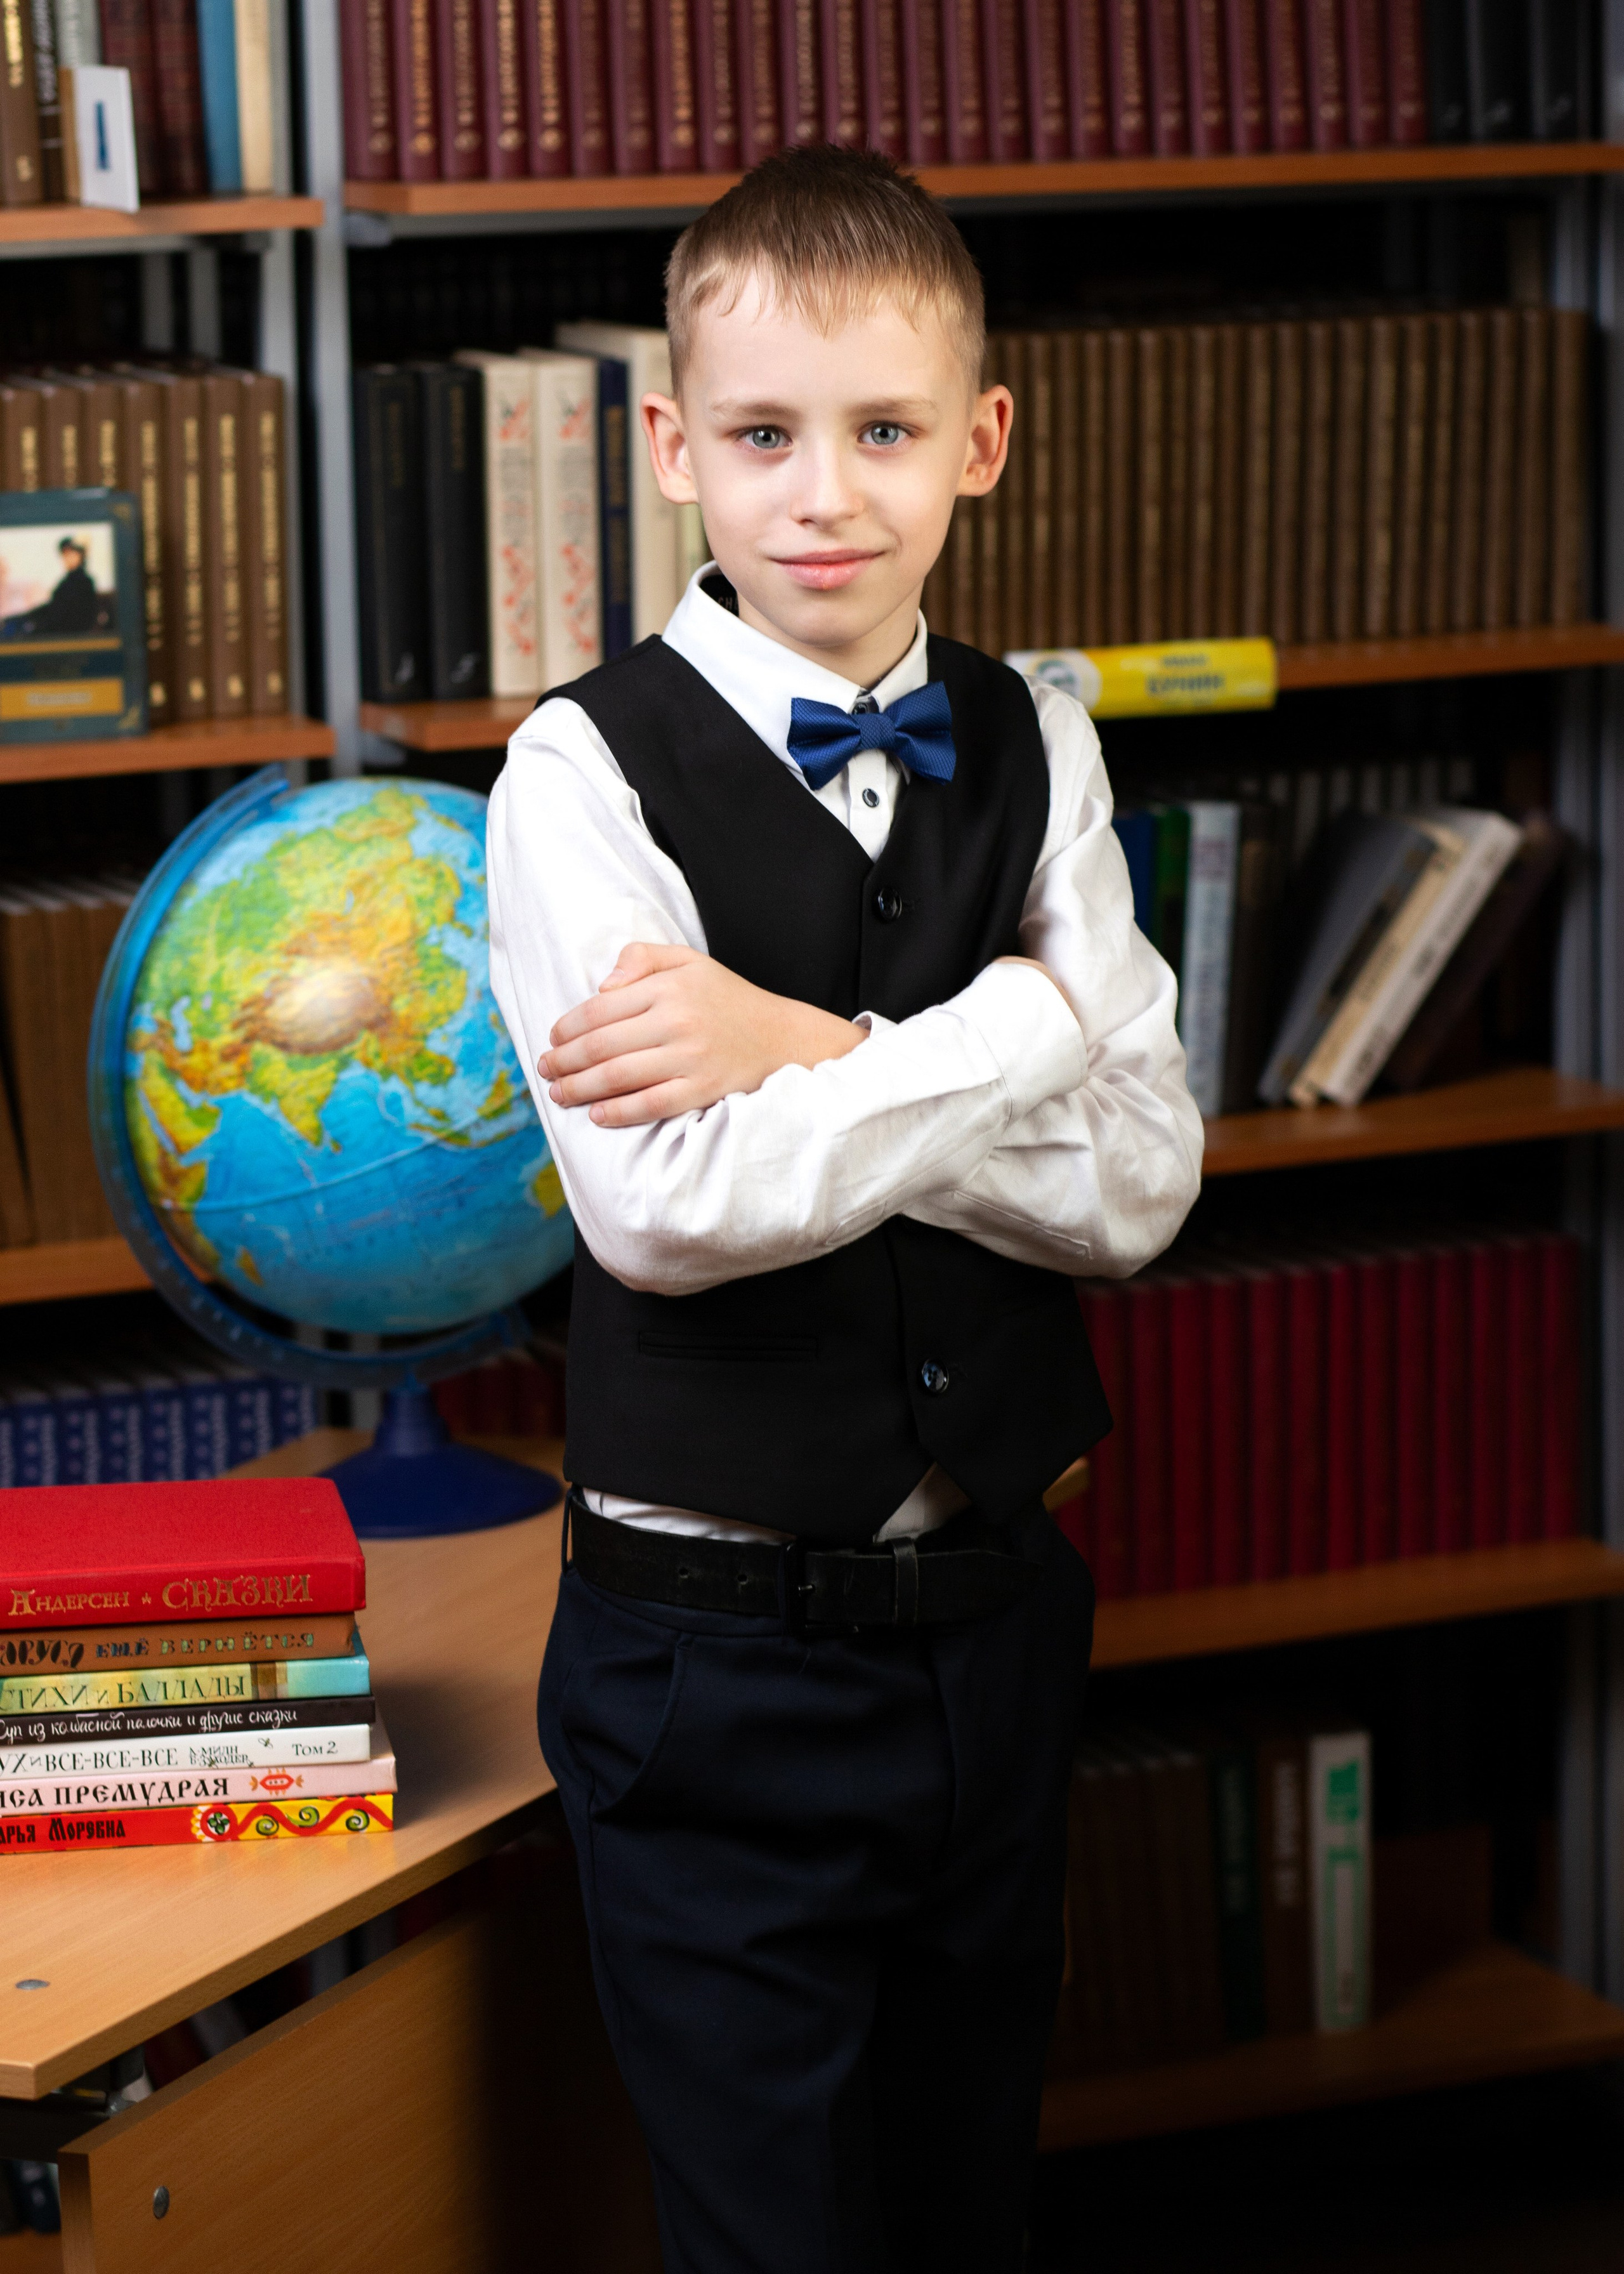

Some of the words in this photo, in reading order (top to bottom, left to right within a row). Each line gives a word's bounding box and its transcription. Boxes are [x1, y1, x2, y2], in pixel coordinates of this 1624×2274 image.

[162, 1574, 313, 1612] СКАЗКИ
[0, 1684, 89, 1712] СТИХИ
[117, 1676, 246, 1703] БАЛЛАДЫ
[29, 1723, 46, 1742] из
[127, 1714, 182, 1730] палочки
[187, 1716, 196, 1726] и
[199, 1711, 243, 1733] другие
[248, 1710, 298, 1730] сказки
[327, 1740, 338, 1754] 2
[54, 1777, 229, 1806] ПРЕМУДРАЯ
